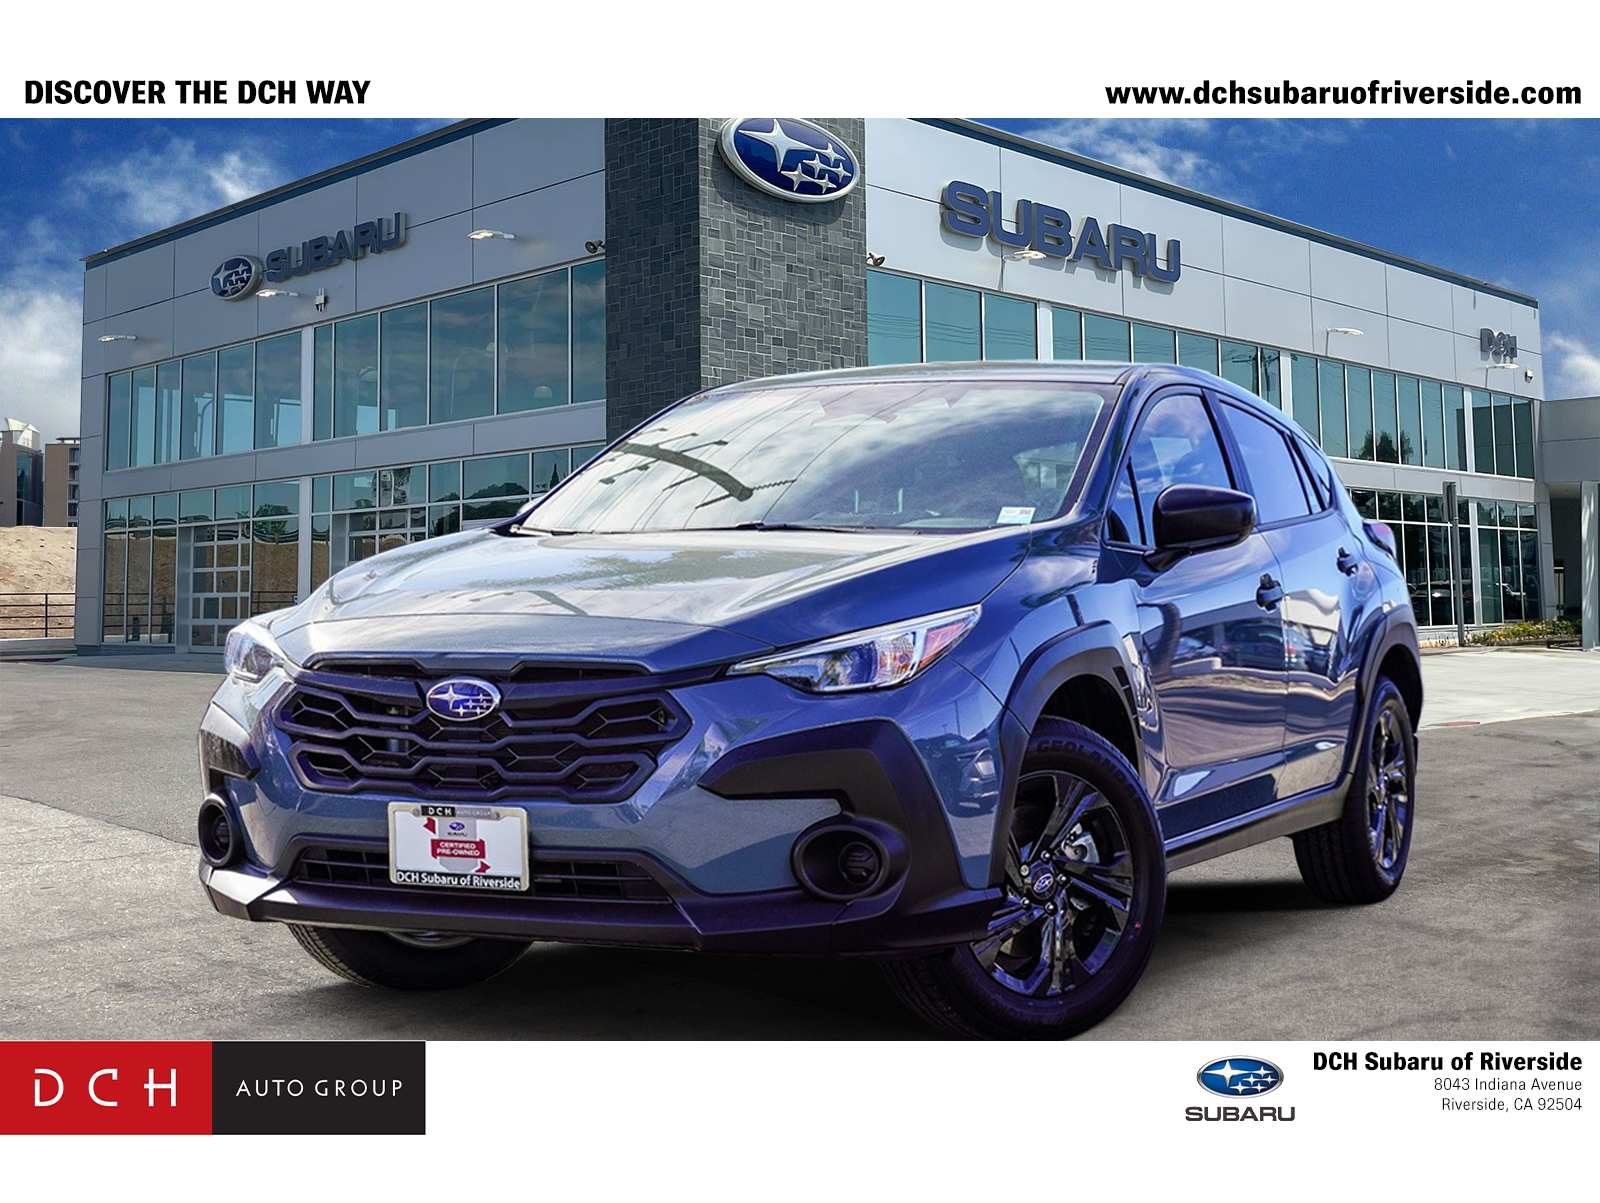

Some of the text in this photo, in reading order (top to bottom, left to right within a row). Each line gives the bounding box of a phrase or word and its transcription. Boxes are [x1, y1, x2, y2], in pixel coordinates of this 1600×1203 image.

[940, 180, 1182, 283] SUBARU
[265, 211, 407, 283] SUBARU
[428, 807, 452, 815] DCH
[436, 847, 480, 857] PRE-OWNED
[439, 841, 477, 850] CERTIFIED
[397, 871, 521, 889] DCH Subaru of Riverside
